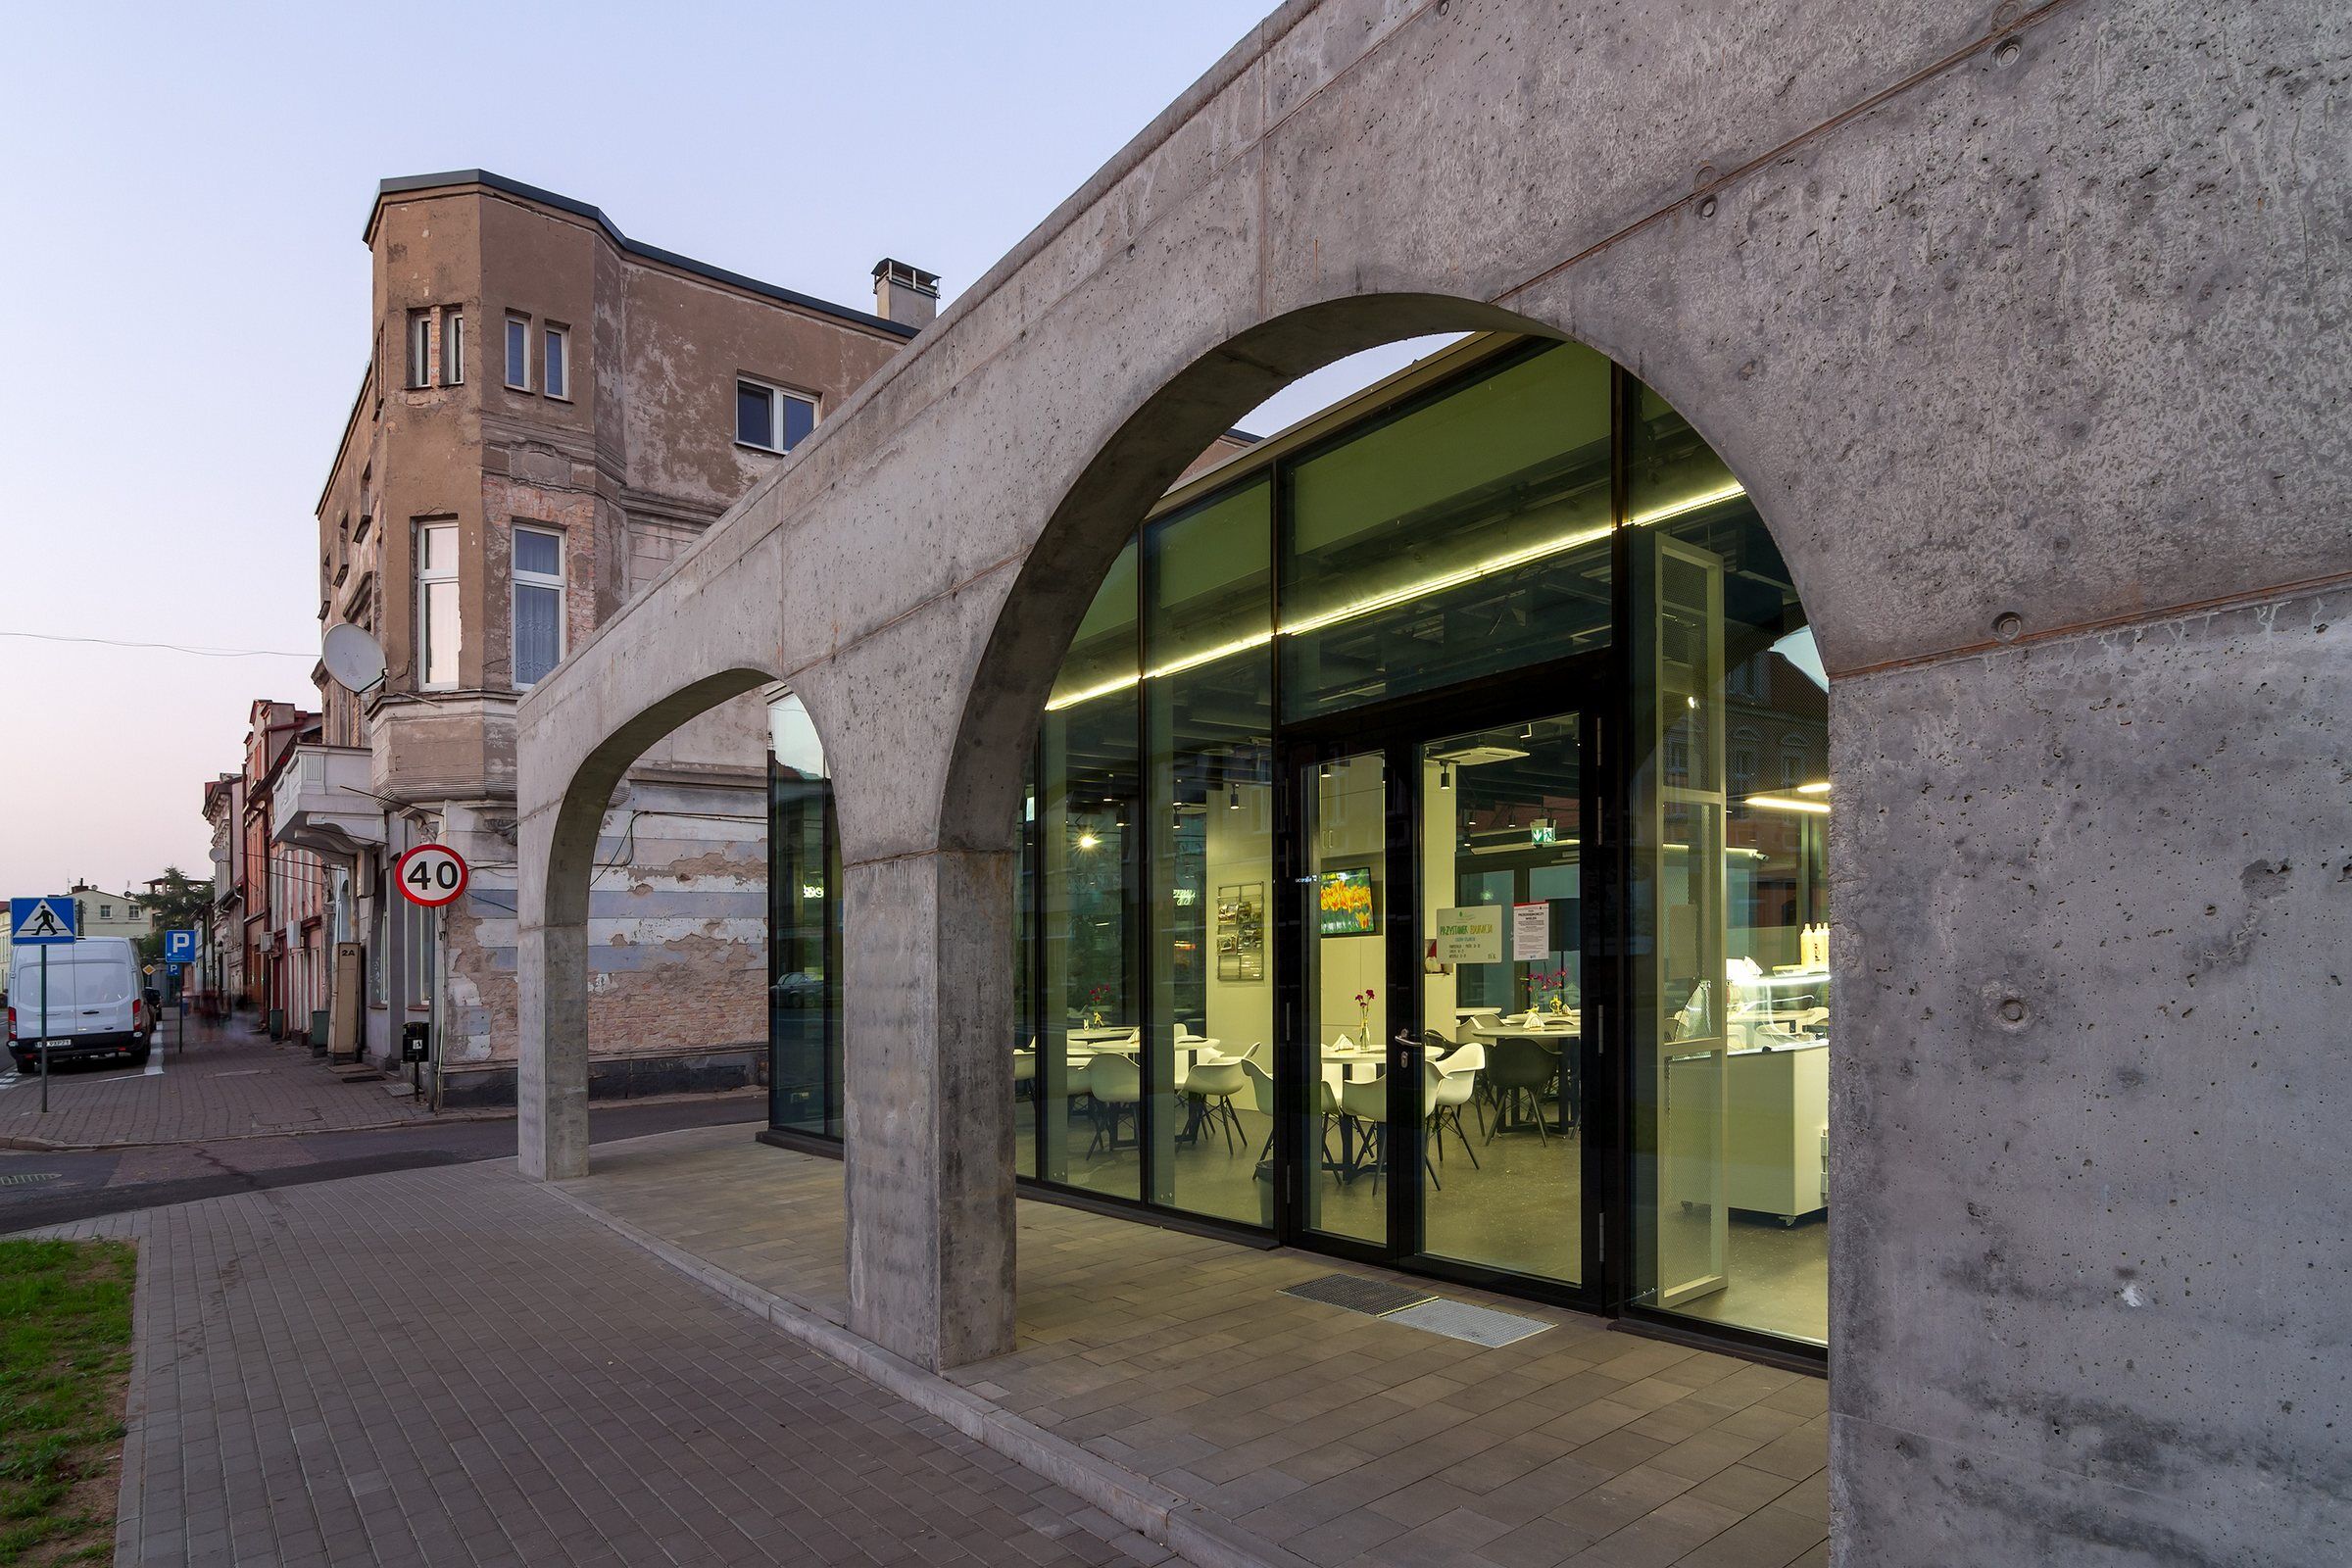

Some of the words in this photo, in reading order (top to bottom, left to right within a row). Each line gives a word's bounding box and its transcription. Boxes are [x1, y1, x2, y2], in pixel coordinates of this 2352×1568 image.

[408, 861, 458, 890] 40
[1440, 925, 1468, 935] PRZYSTANEK
[1470, 924, 1493, 934] EDUKACJA
[173, 933, 189, 953] P
